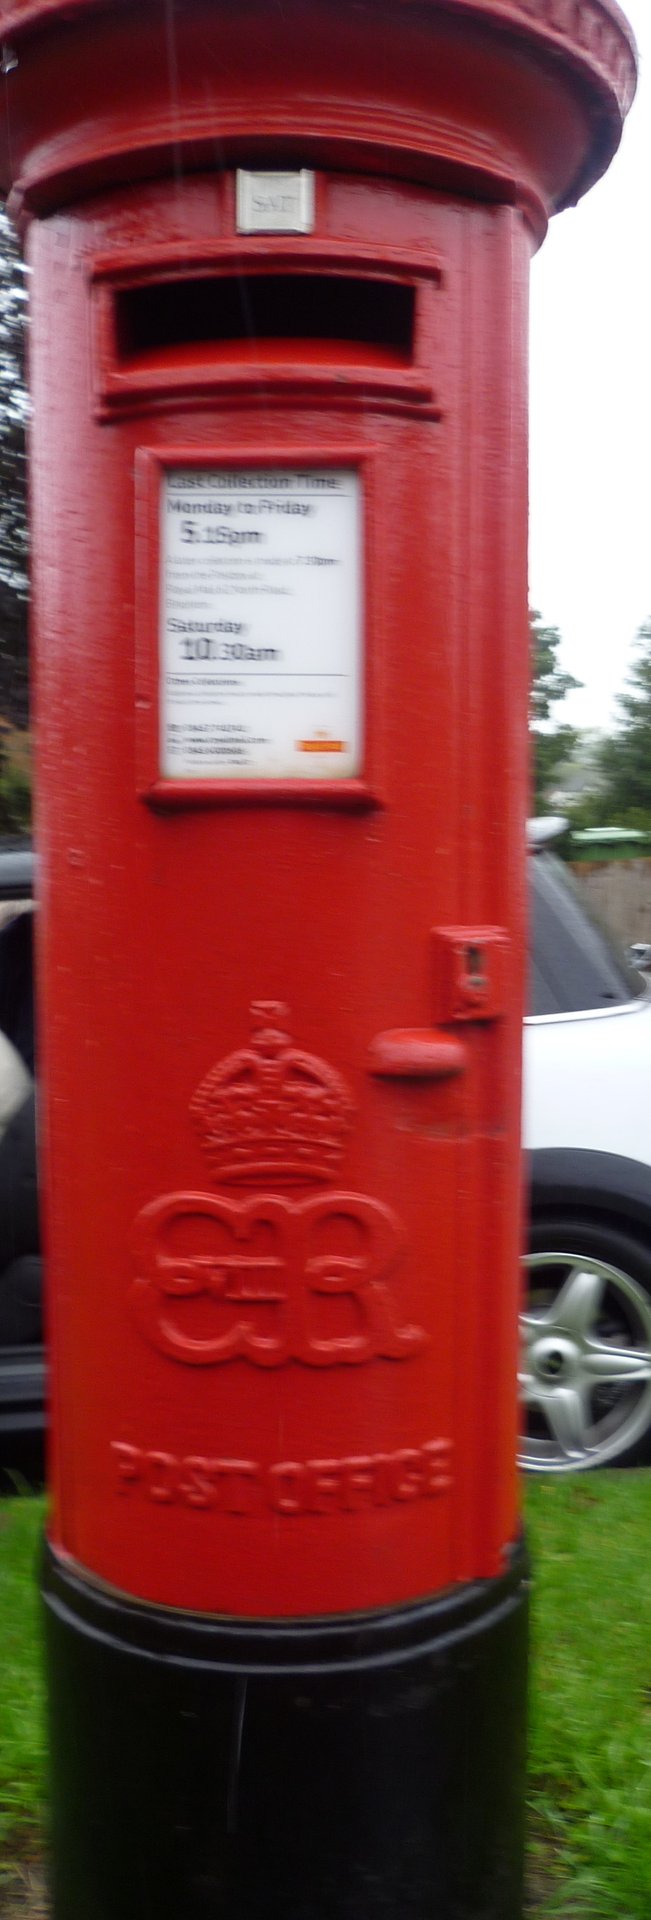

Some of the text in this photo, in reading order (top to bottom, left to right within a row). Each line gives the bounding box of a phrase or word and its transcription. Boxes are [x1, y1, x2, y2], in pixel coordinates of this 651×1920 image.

[166, 473, 202, 490] Last
[205, 473, 291, 490] Collection
[167, 499, 313, 517] Monday to Friday
[166, 617, 246, 635] Saturday
[179, 637, 281, 662] 10.30am
[110, 1438, 454, 1517] POST OFFICE
